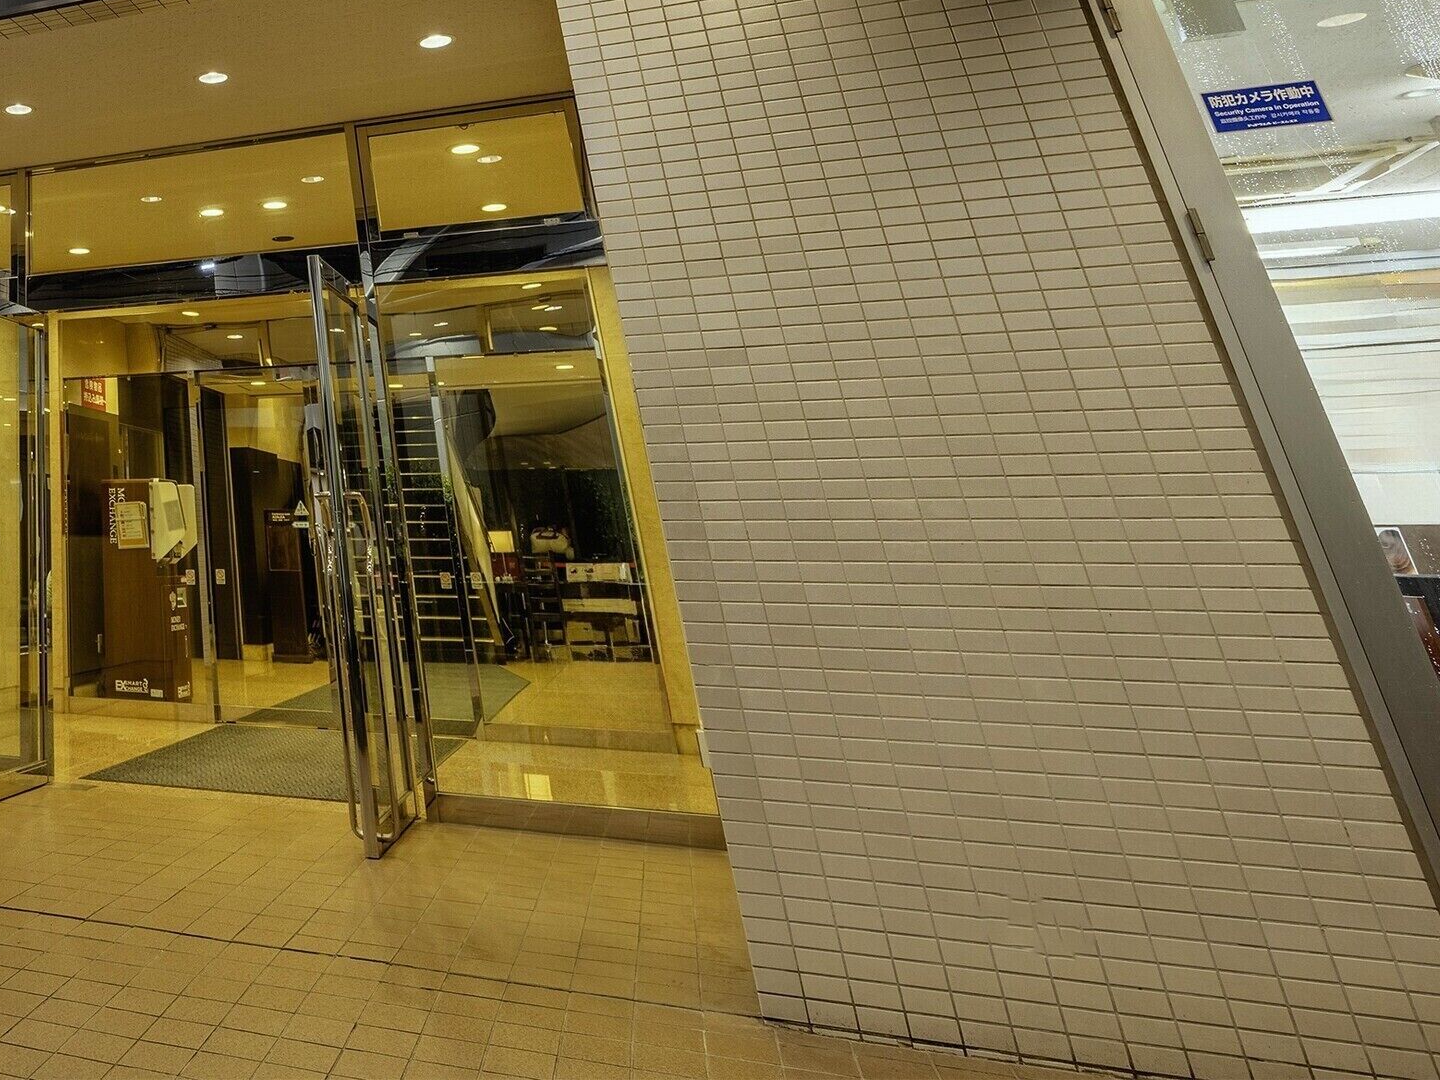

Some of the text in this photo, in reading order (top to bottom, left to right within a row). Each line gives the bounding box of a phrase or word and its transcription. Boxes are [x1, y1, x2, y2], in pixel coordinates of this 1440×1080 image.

[1207, 85, 1315, 109] 防犯カメラ作動中
[1214, 107, 1244, 118] Security
[1245, 103, 1274, 114] Camera
[1283, 100, 1320, 111] Operation
[109, 487, 118, 544] EXCHANGE
